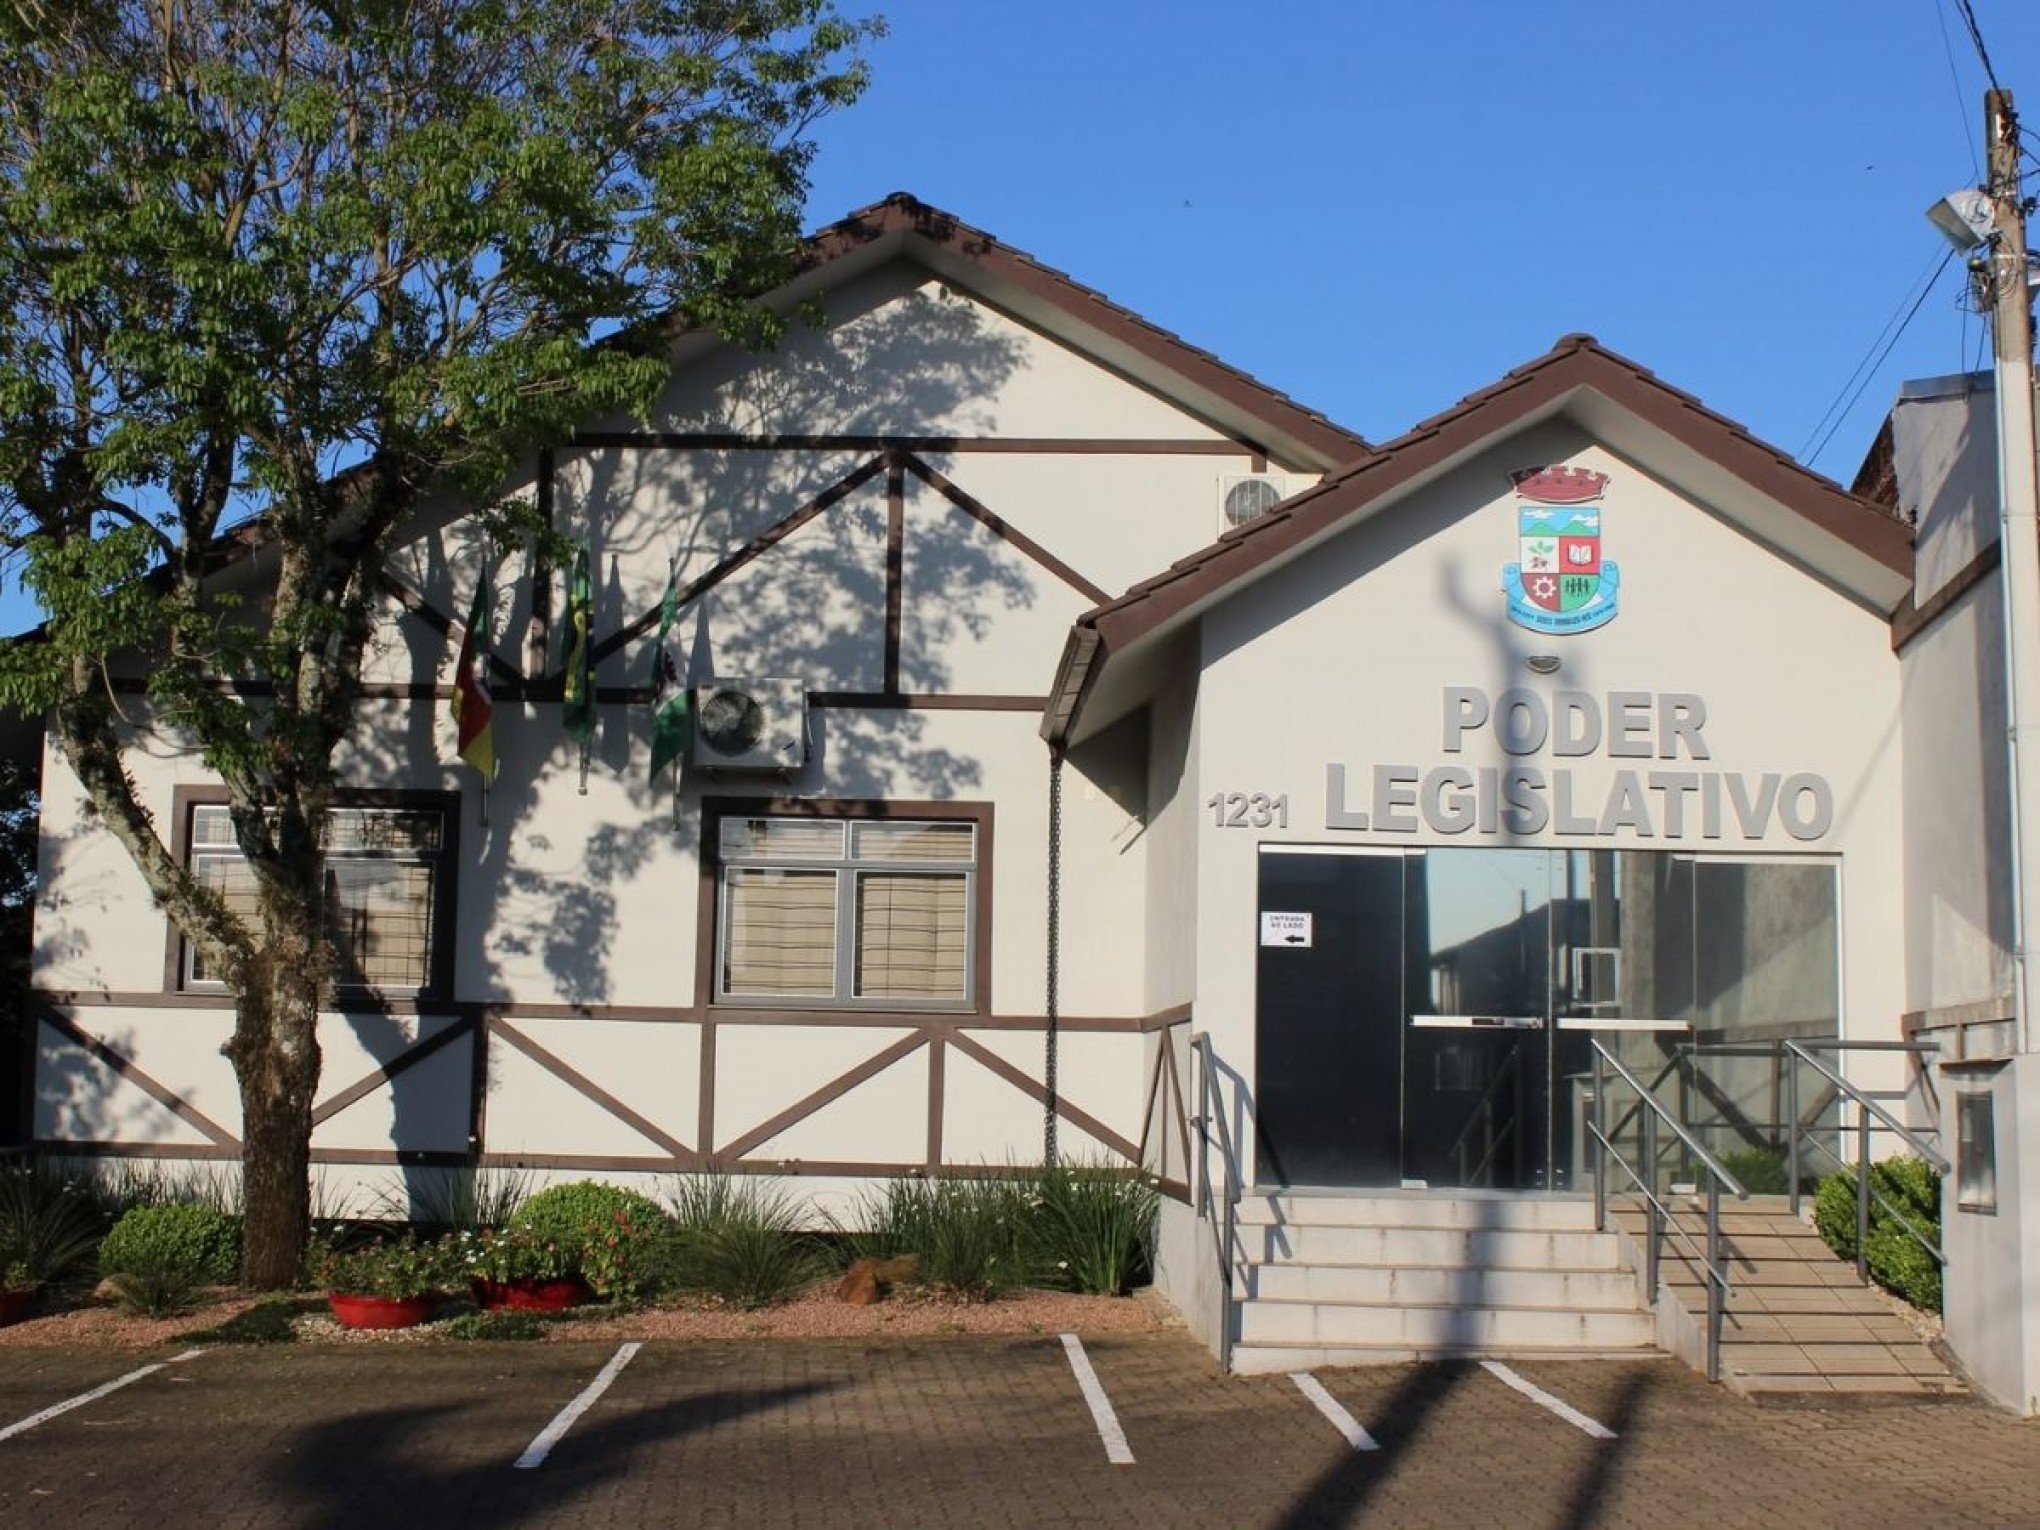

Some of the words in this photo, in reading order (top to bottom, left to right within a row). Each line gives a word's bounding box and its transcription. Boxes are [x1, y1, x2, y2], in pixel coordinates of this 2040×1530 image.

[1443, 686, 1711, 760] PODER
[1208, 792, 1288, 828] 1231
[1326, 763, 1834, 841] LEGISLATIVO
